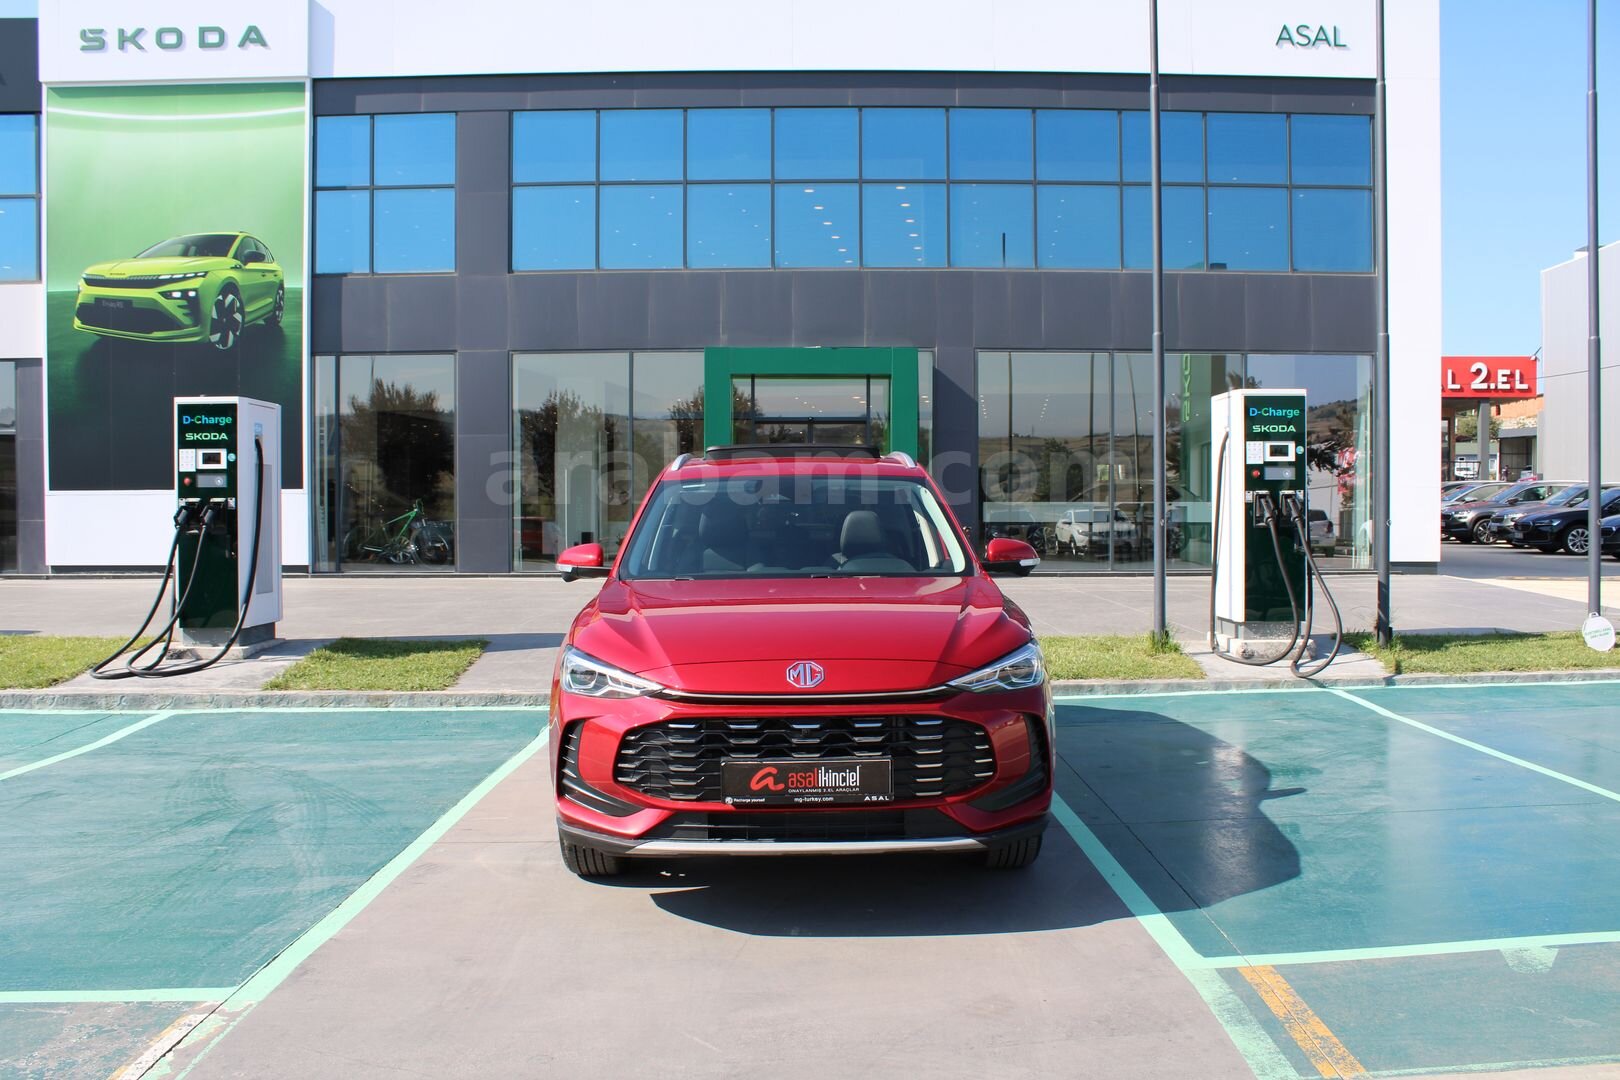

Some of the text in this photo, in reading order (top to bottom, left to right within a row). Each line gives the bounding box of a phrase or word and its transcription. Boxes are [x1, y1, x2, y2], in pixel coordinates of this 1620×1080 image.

[79, 25, 268, 51] SKODA
[1275, 24, 1347, 47] ASAL
[1470, 361, 1529, 390] 2.EL
[182, 415, 232, 426] D-Charge
[1249, 407, 1300, 418] D-Charge
[185, 432, 228, 440] SKODA
[788, 662, 822, 686] MG
